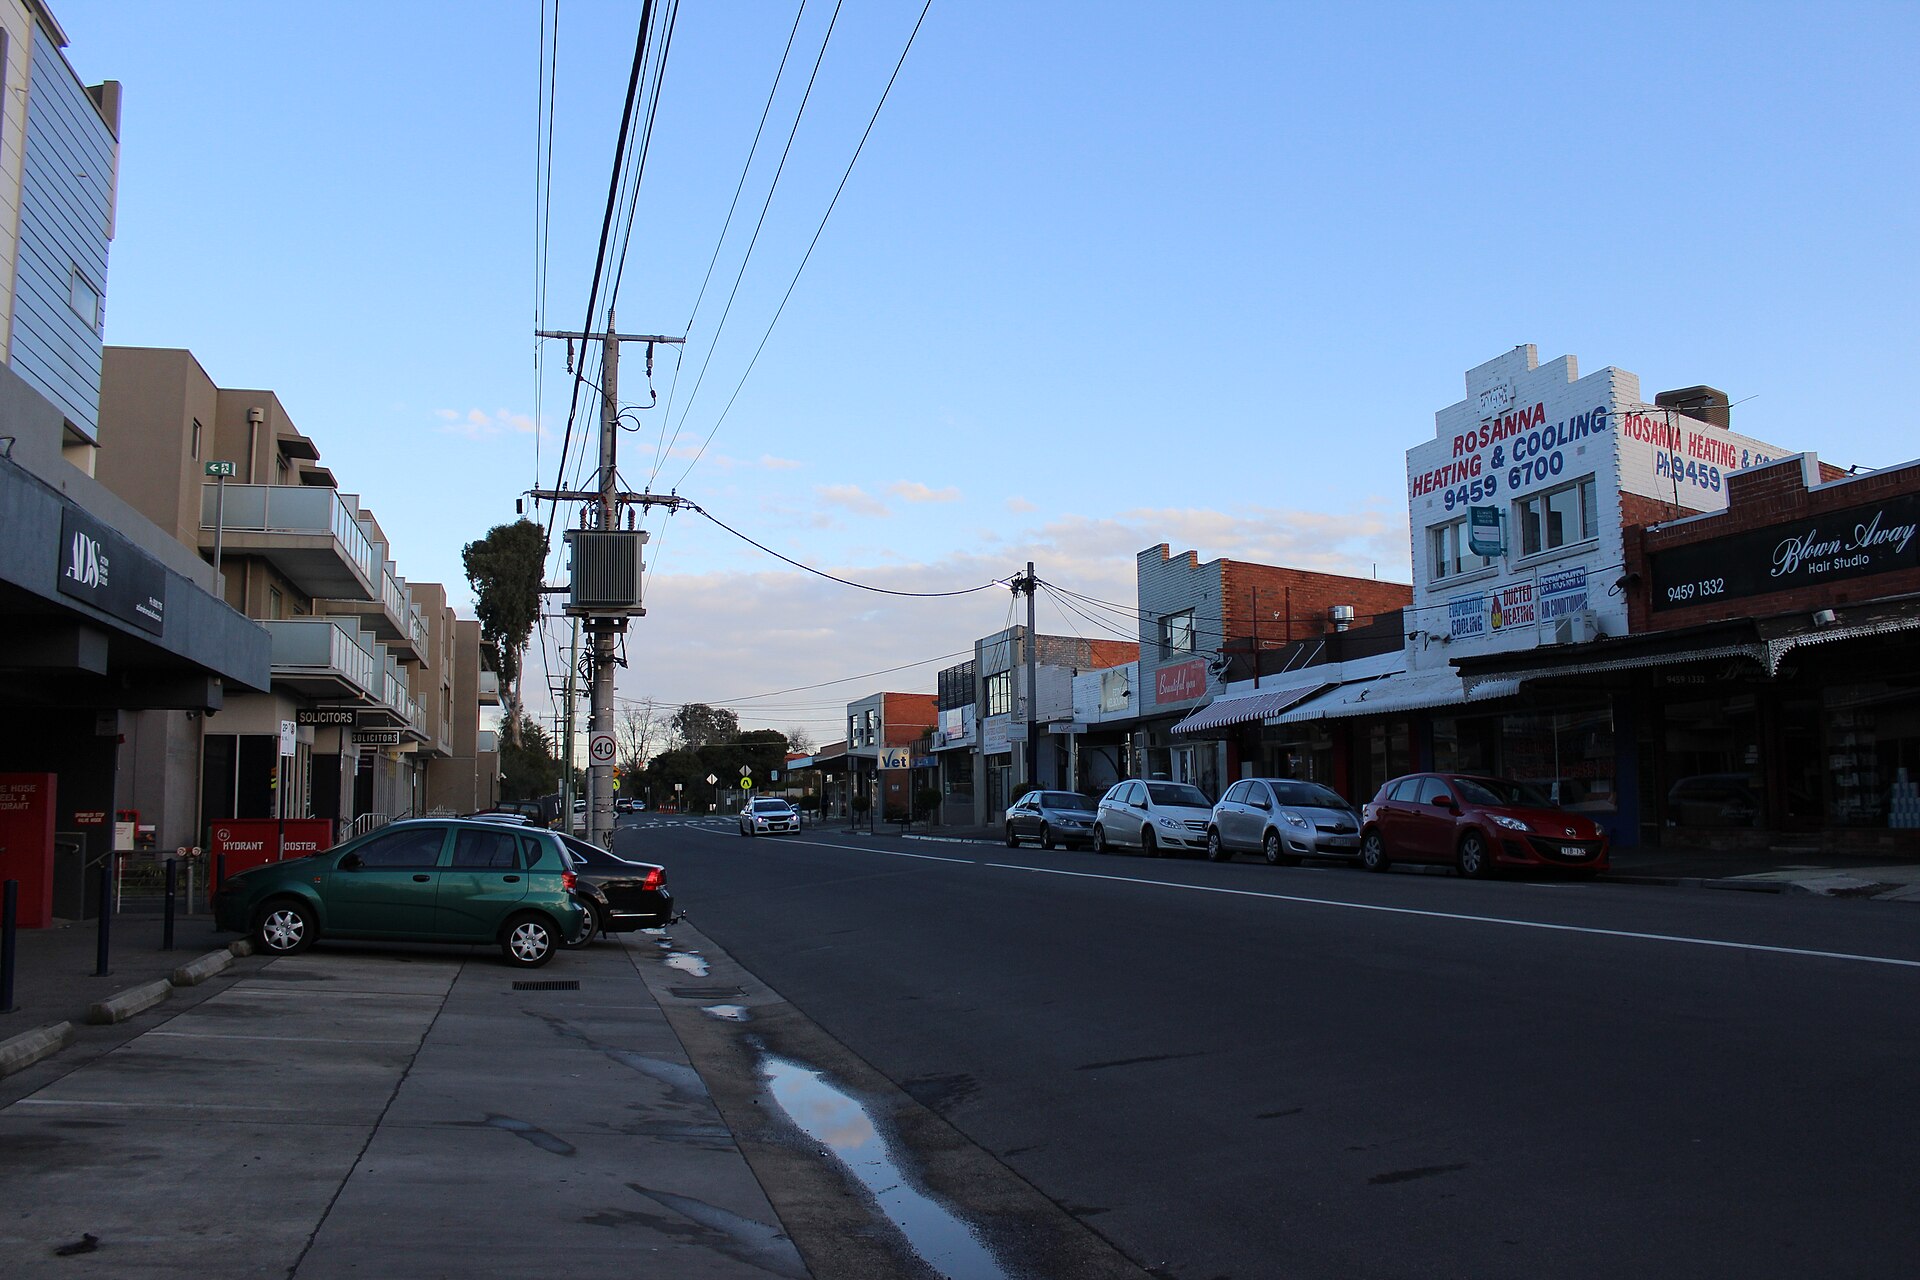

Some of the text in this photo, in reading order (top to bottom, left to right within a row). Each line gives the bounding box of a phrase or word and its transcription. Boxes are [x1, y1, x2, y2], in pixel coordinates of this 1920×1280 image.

[1452, 402, 1546, 458] ROSANNA
[1624, 412, 1750, 469] ROSANNA HEATING &
[1412, 406, 1607, 498] HEATING & COOLING
[1444, 451, 1564, 511] 9459 6700
[1770, 510, 1916, 577] Blown Away
[66, 530, 101, 588] ADS
[1808, 554, 1870, 574] Hair Studio
[1503, 584, 1532, 606] DUCTED
[1667, 578, 1724, 601] 9459 1332
[1503, 604, 1534, 626] HEATING
[1541, 592, 1588, 619] AIR CONDITIONING
[1452, 615, 1482, 635] COOLING
[1159, 669, 1186, 696] Beautiful
[1688, 675, 1705, 683] 1332
[300, 712, 353, 723] SOLICITORS
[352, 734, 397, 742] SOLICITORS
[594, 742, 613, 755] 40
[882, 749, 907, 767] Vet
[11, 784, 37, 793] HOSE
[0, 802, 31, 810] DRANT
[223, 841, 317, 851] HYDRANT OOSTER
